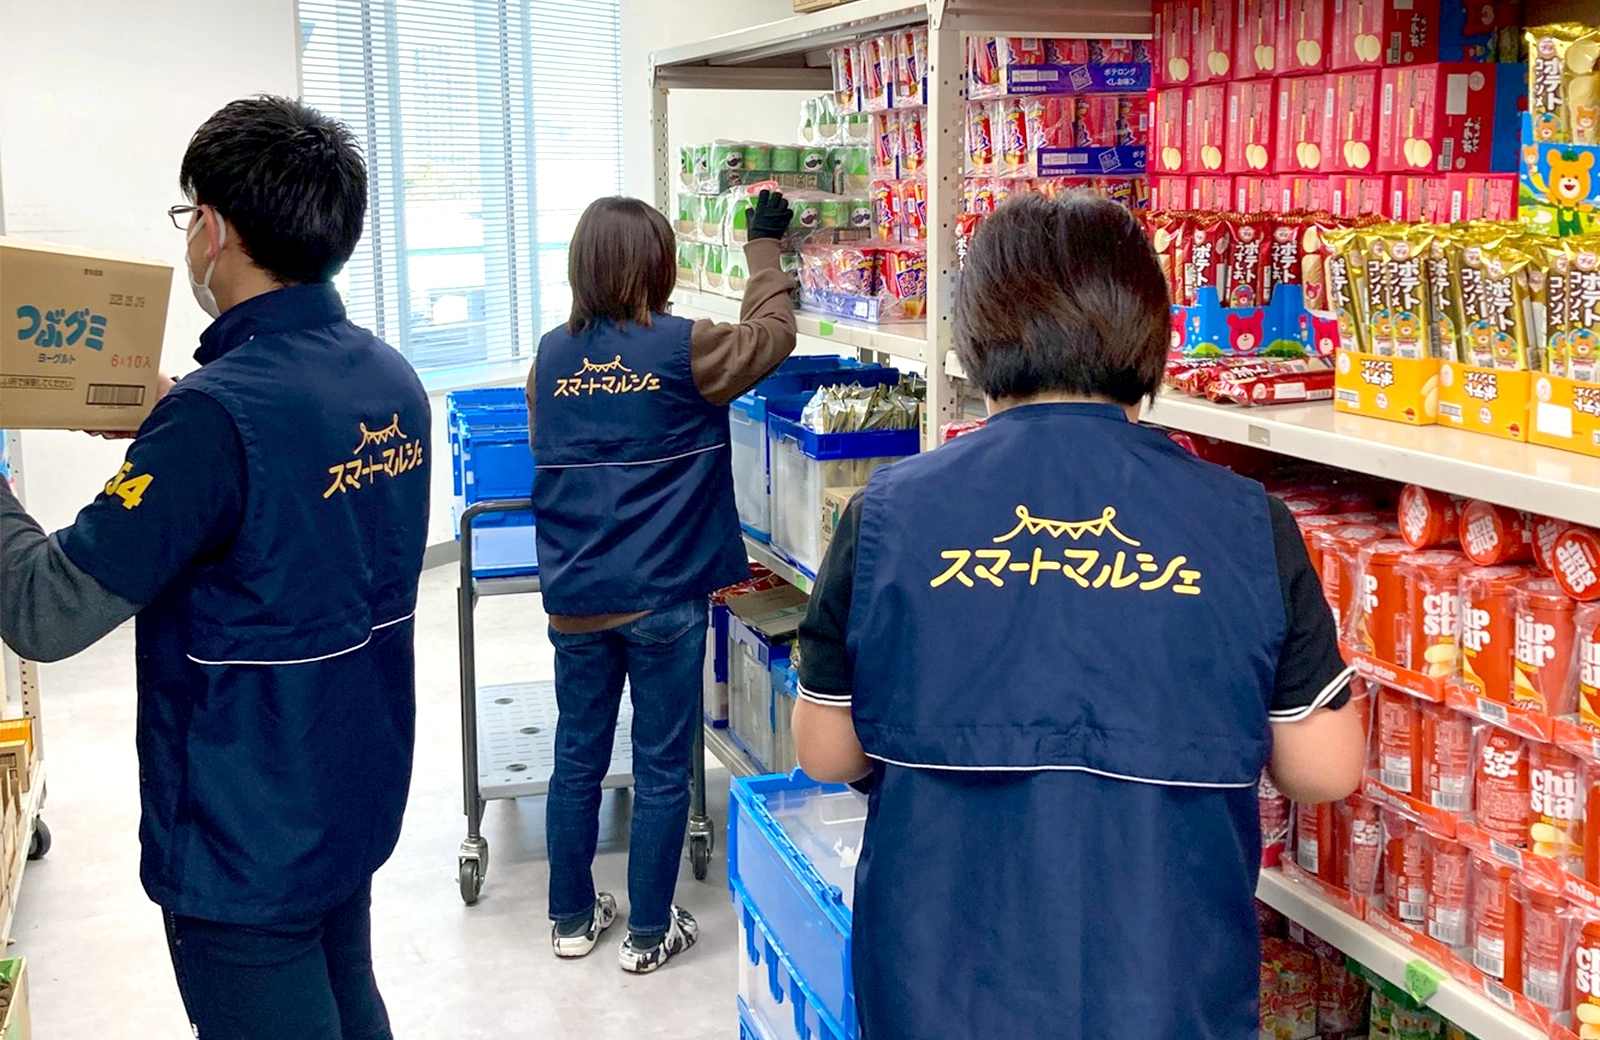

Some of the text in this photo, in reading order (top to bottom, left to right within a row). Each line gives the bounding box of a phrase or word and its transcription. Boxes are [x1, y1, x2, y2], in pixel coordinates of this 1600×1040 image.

[1196, 242, 1212, 286] ポテト
[1233, 242, 1245, 279] うすしお
[1244, 239, 1260, 283] ポテト
[1280, 240, 1297, 283] ポテト
[1331, 257, 1350, 306] ポテト
[1368, 260, 1381, 305] コンソメ
[1388, 261, 1400, 306] コンソメ
[1398, 257, 1420, 310] ポテト
[1436, 257, 1451, 310] ポテト
[1461, 268, 1476, 315] コンソメ
[1493, 277, 1515, 330] ポテト
[1550, 276, 1563, 325] コンソメ
[1569, 271, 1582, 321] コンソメ
[17, 305, 107, 351] つぶグミ
[38, 353, 76, 364] ヨーグルト
[553, 373, 661, 397] スマートマルシェ
[323, 439, 422, 499] スマートマルシェ
[1467, 516, 1494, 542] star
[1470, 530, 1499, 556] chip
[929, 547, 1201, 594] スマートマルシェ
[1556, 546, 1585, 593] chip
[1565, 540, 1597, 586] star
[1423, 592, 1461, 616] ch
[1463, 602, 1490, 630] ip
[1463, 628, 1491, 652] ar
[1516, 611, 1556, 645] hip
[1483, 745, 1520, 765] チップ
[1483, 760, 1519, 778] スター
[1531, 768, 1587, 803] chi
[1531, 790, 1587, 823] sta
